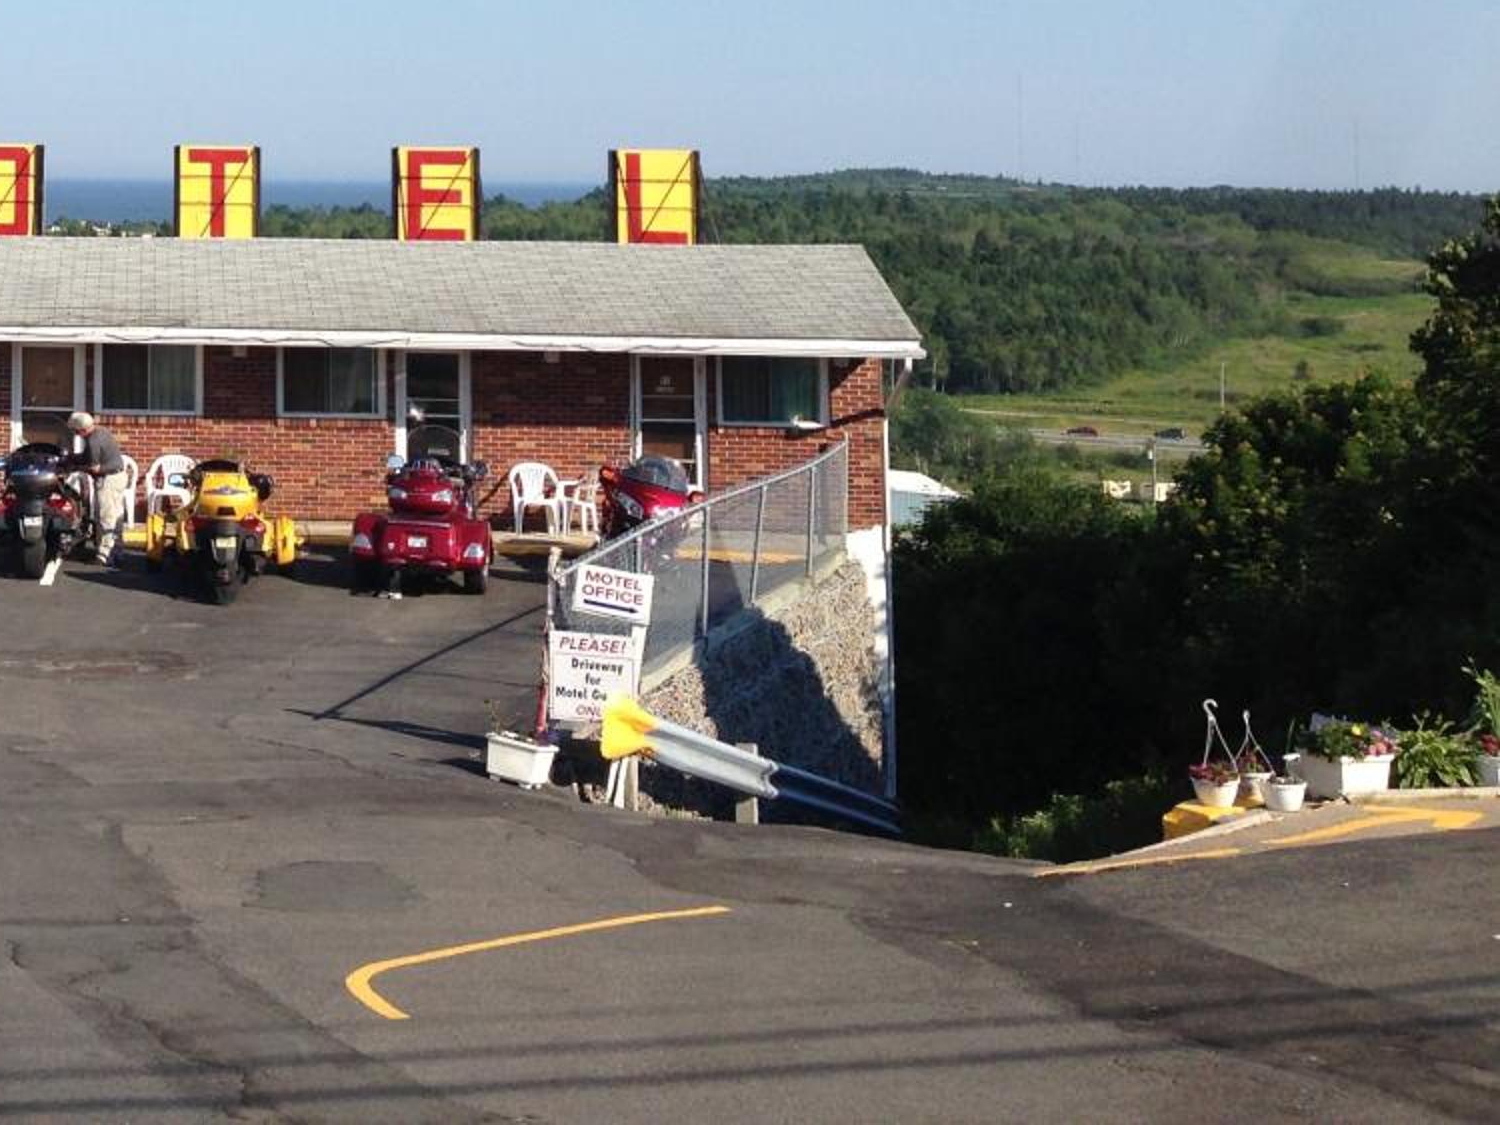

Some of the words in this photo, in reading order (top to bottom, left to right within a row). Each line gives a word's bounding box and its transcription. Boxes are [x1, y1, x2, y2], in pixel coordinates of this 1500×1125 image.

[585, 570, 642, 591] MOTEL
[582, 585, 644, 606] OFFICE
[559, 636, 626, 654] PLEASE!
[585, 674, 600, 684] for
[556, 688, 587, 699] Motel
[575, 704, 603, 717] ONL
